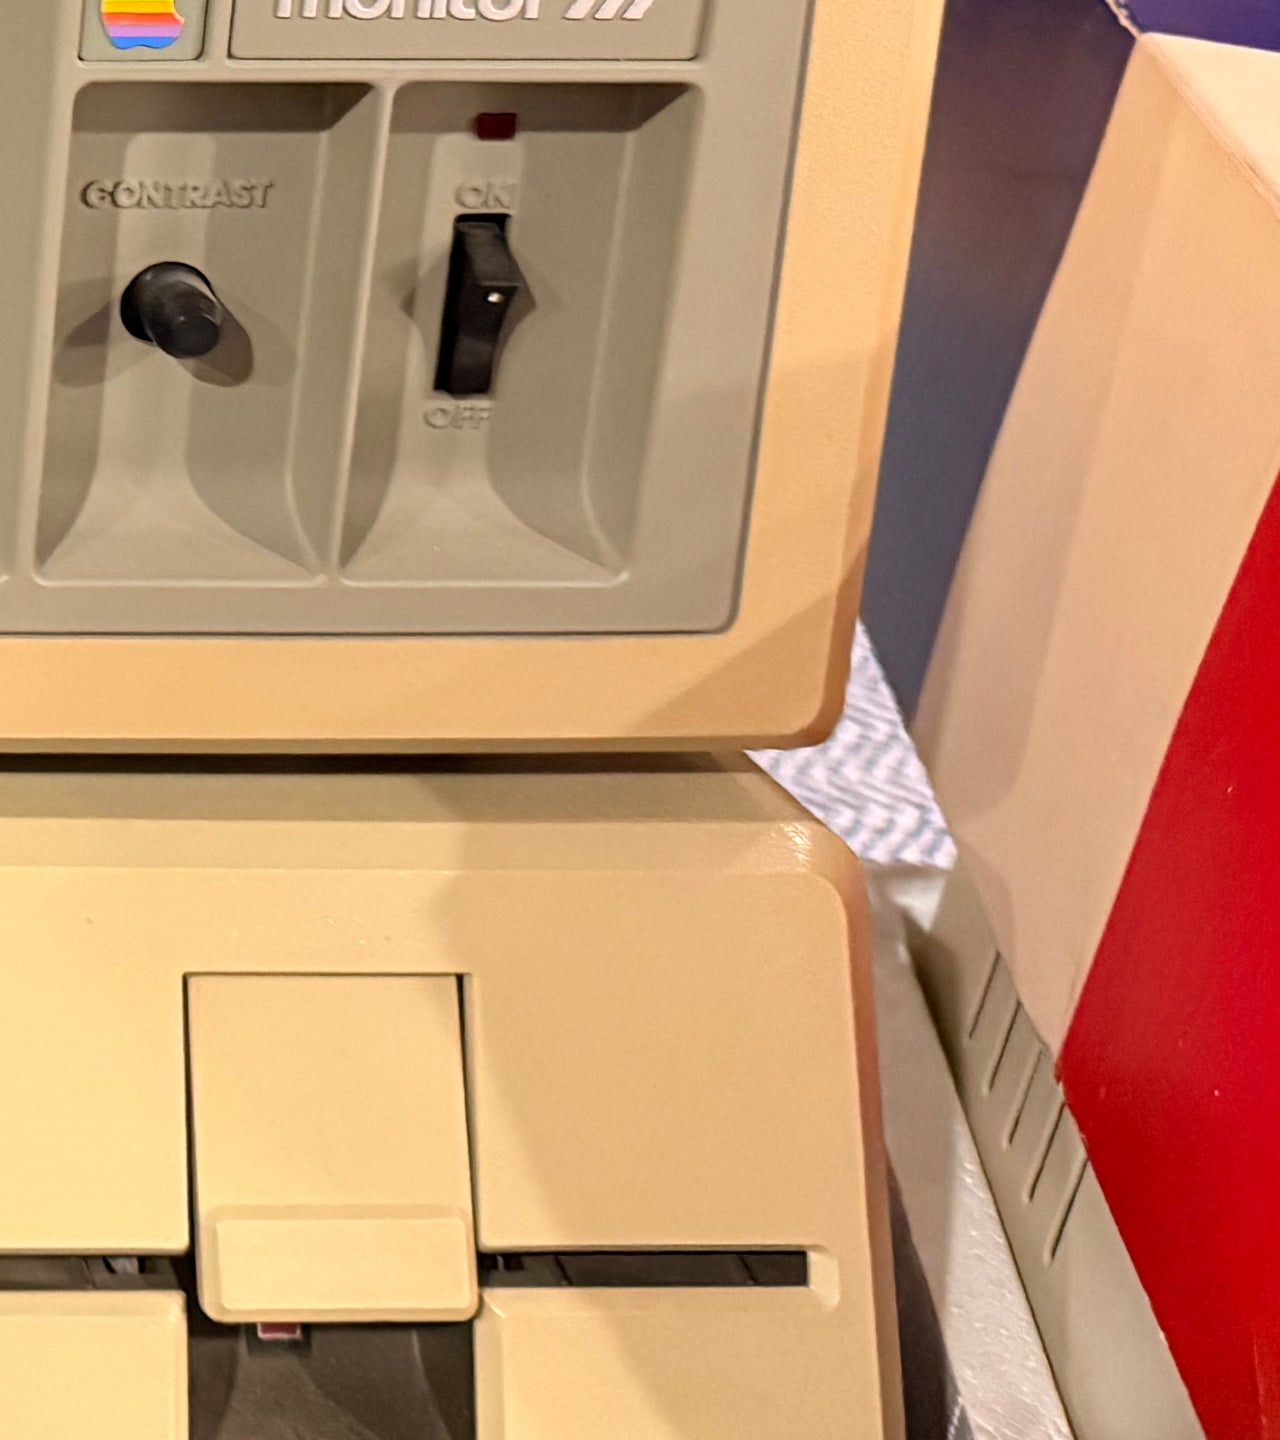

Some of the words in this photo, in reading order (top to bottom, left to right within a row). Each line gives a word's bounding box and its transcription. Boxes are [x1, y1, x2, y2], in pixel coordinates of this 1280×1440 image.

[80, 178, 275, 210] CONTRAST
[453, 179, 516, 210] ON
[422, 403, 493, 430] OFF
